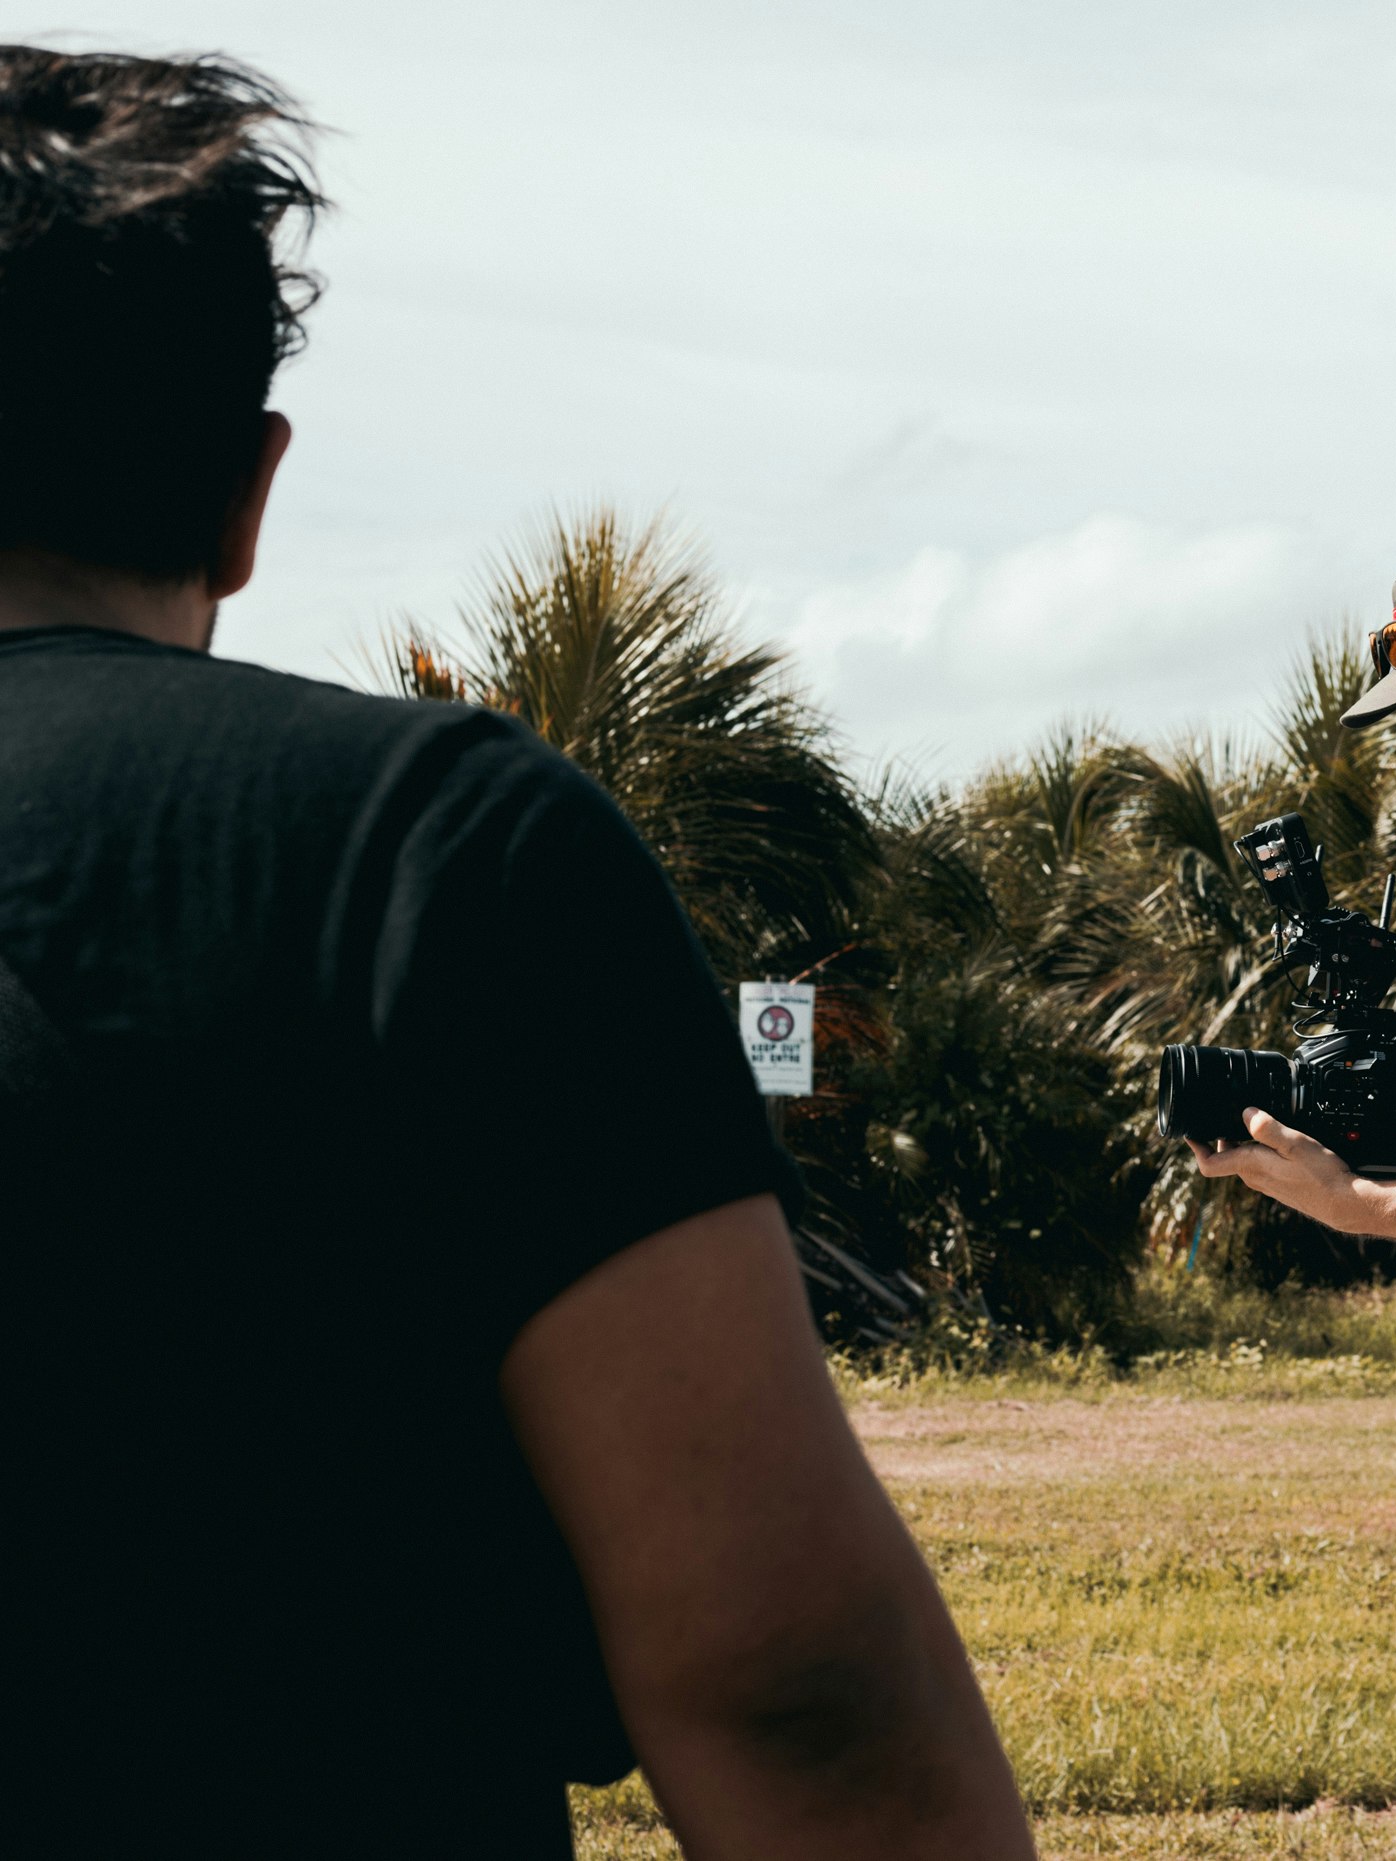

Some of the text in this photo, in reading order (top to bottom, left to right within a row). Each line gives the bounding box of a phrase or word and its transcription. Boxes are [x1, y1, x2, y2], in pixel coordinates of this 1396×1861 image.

[751, 1044, 800, 1052] KEEP OUT
[751, 1054, 764, 1062] NO
